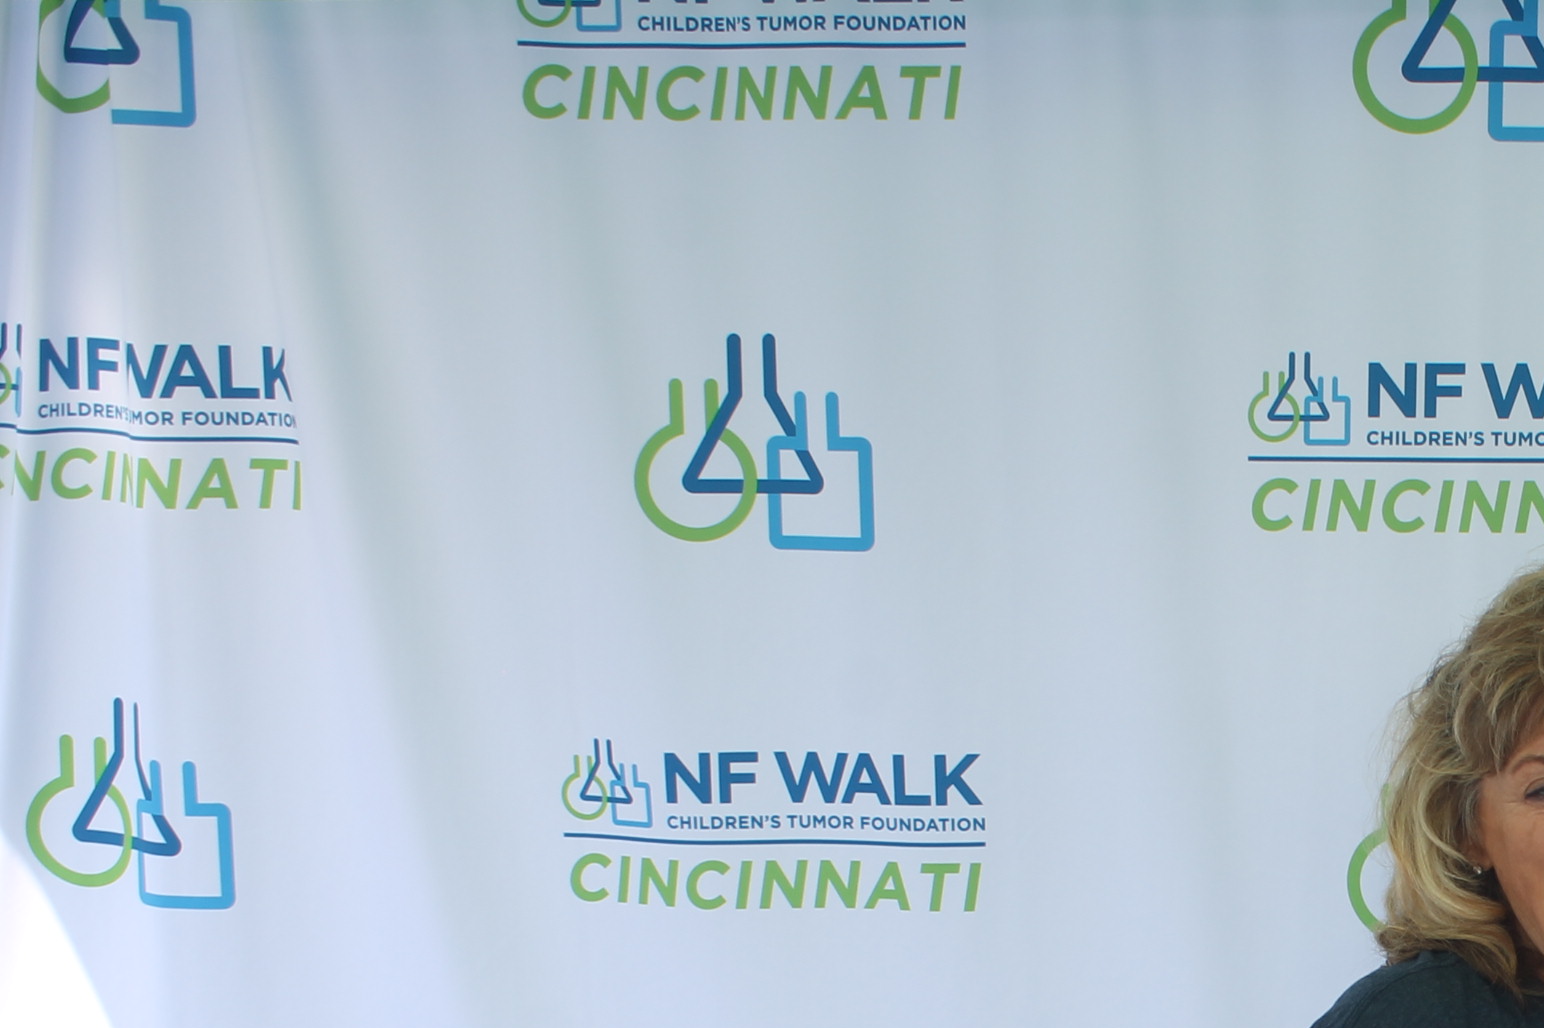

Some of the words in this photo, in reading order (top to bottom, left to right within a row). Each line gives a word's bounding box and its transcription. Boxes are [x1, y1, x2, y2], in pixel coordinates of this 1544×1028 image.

[637, 15, 751, 32] CHILDREN'S
[756, 15, 826, 32] TUMOR
[834, 15, 966, 31] FOUNDATION
[522, 63, 961, 121] CINCINNATI
[39, 336, 120, 392] NF
[1368, 362, 1466, 418] NF
[129, 410, 174, 426] MOR
[1366, 430, 1485, 447] CHILDREN'S
[663, 751, 758, 804] NF
[774, 751, 983, 807] WALK
[666, 815, 781, 830] CHILDREN'S
[786, 815, 854, 831] TUMOR
[860, 816, 986, 832] FOUNDATION
[570, 853, 982, 912] CINCINNATI
